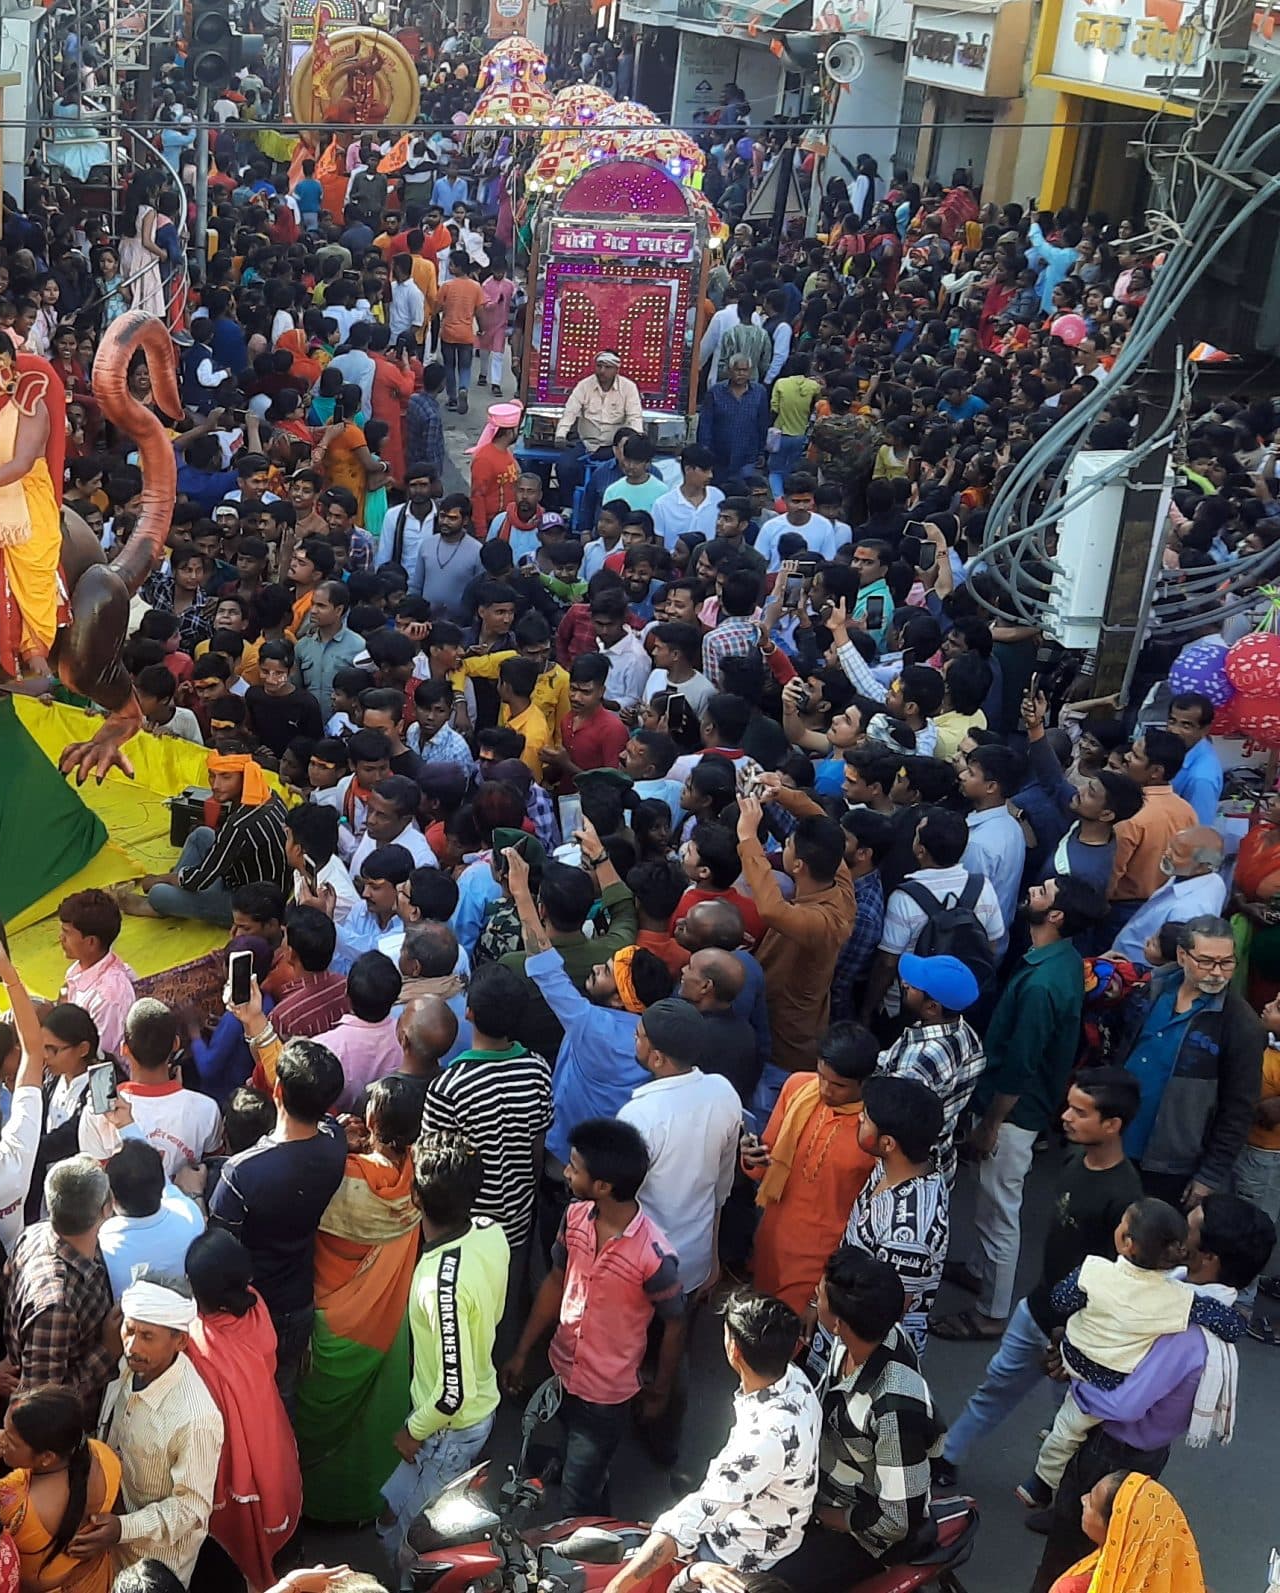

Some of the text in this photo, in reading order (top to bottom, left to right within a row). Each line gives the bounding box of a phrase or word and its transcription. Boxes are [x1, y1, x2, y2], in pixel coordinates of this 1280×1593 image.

[440, 1256, 458, 1283] NEW
[439, 1286, 457, 1323] YORK
[444, 1336, 457, 1366] NEW
